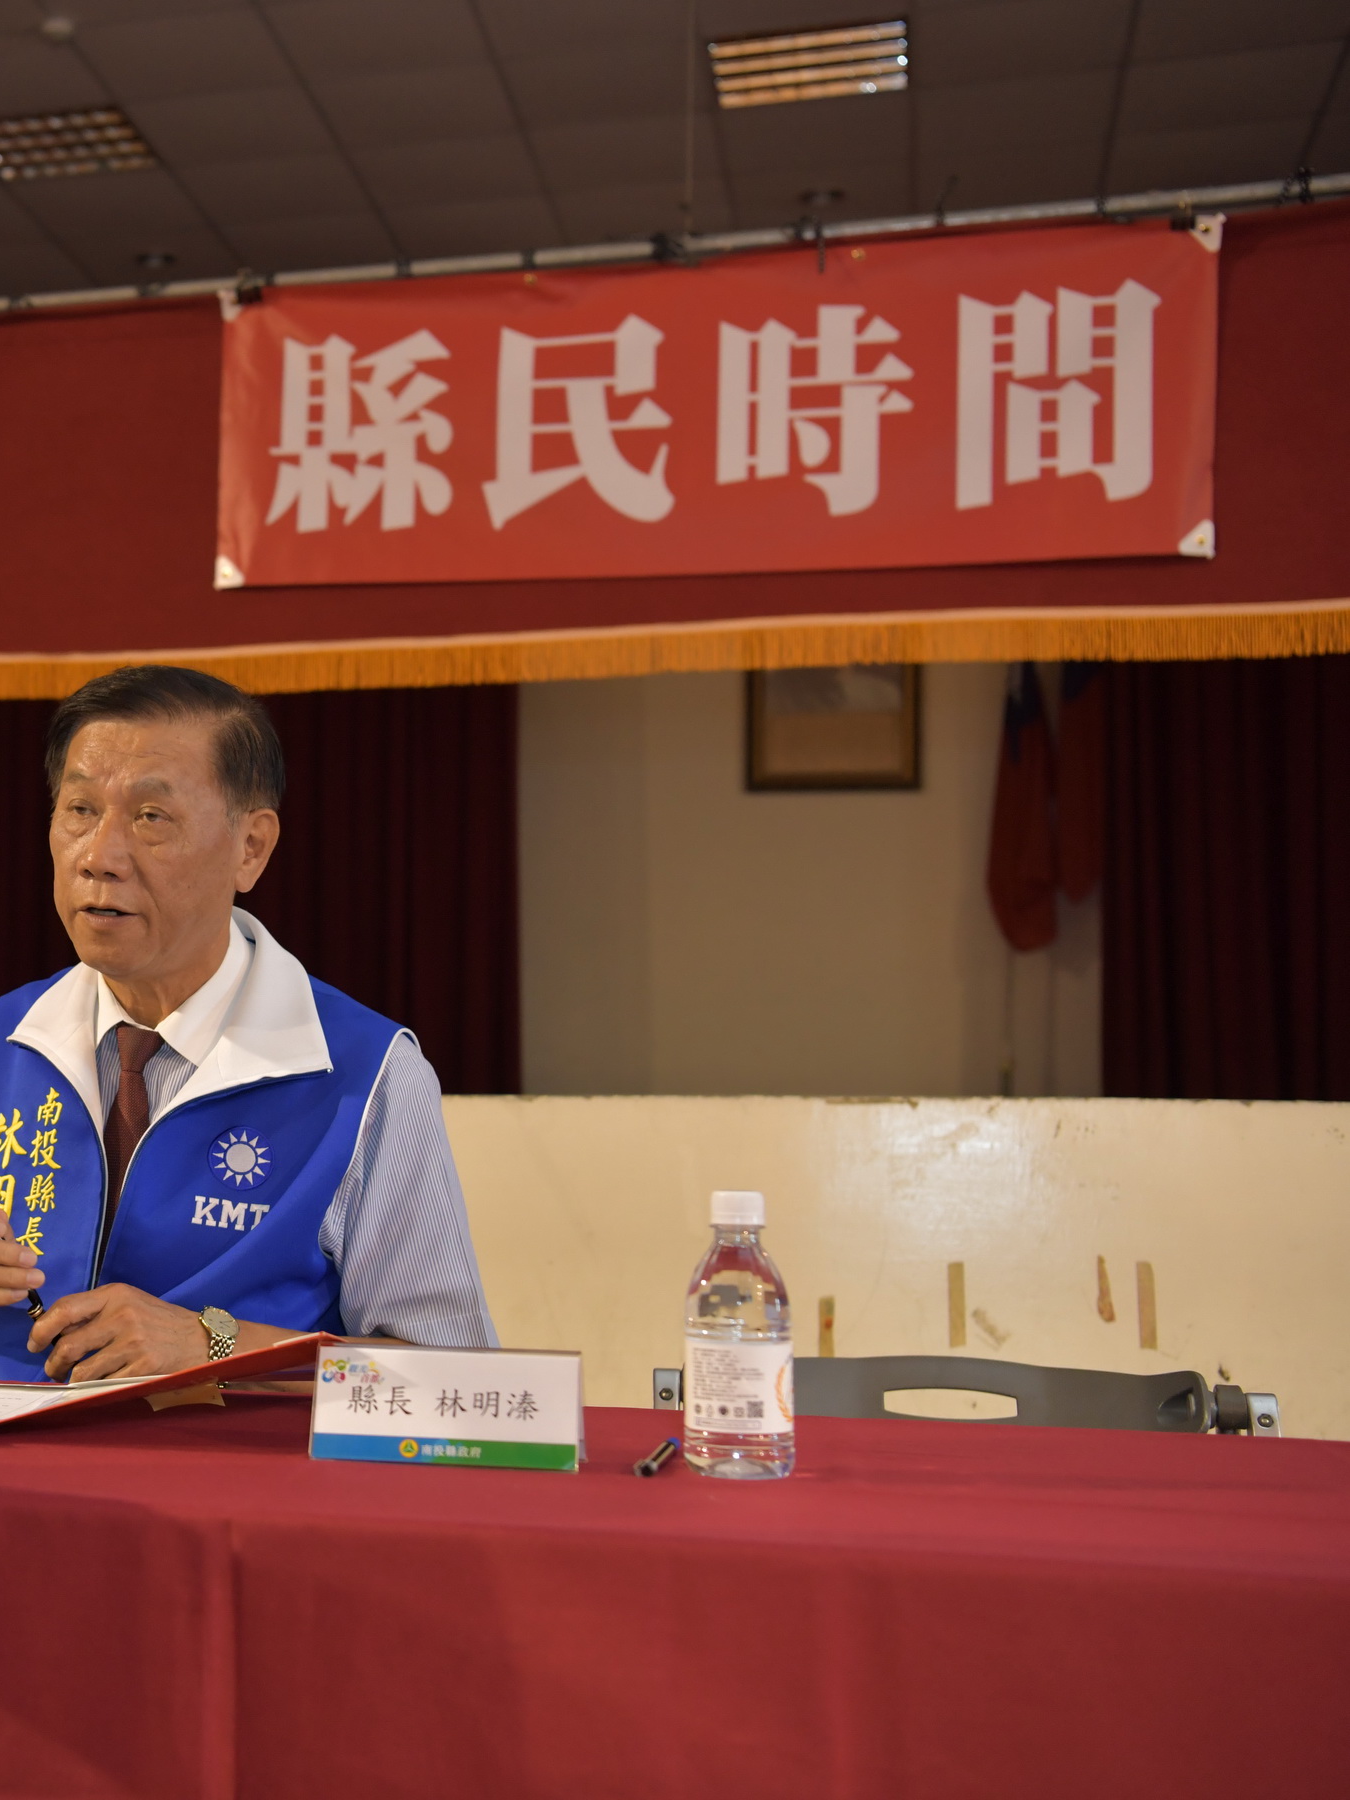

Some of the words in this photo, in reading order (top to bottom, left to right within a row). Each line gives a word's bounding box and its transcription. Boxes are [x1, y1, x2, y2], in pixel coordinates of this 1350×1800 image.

[264, 277, 1161, 533] 縣民時間
[15, 1086, 63, 1256] 南投縣長
[191, 1195, 270, 1231] KMT
[347, 1384, 413, 1416] 縣長
[434, 1389, 540, 1421] 林明溱
